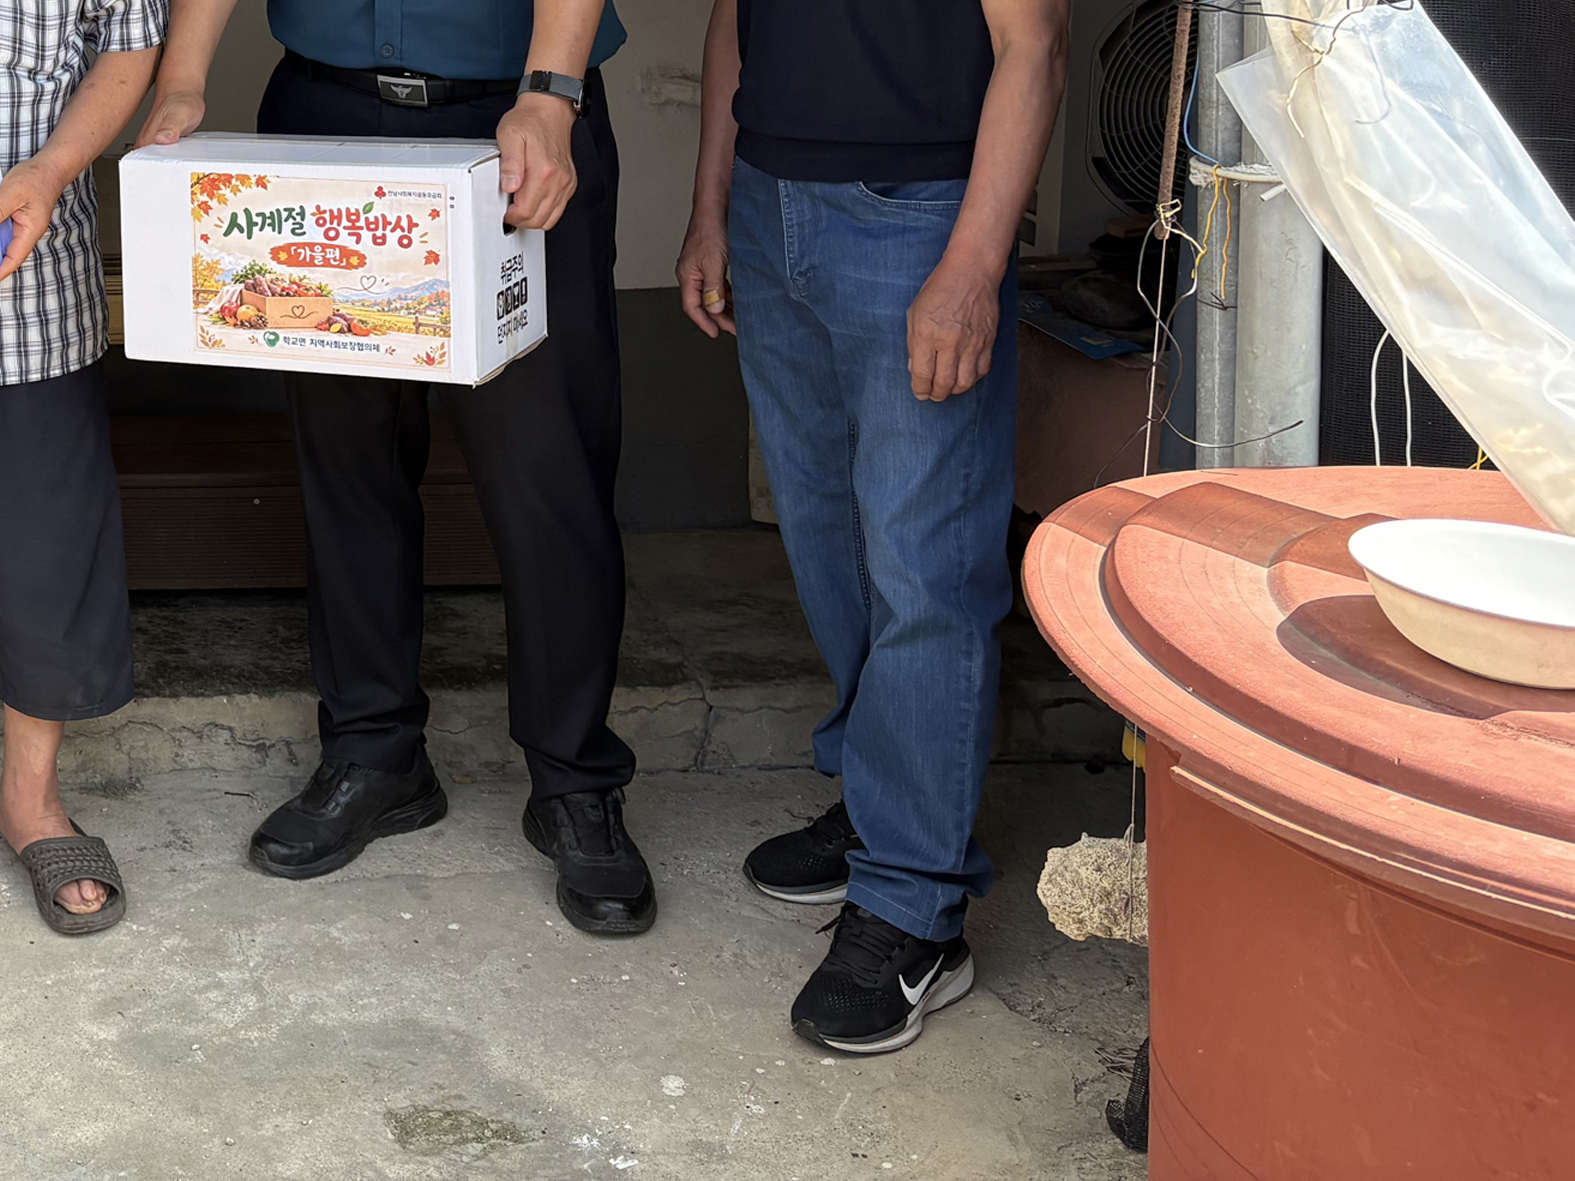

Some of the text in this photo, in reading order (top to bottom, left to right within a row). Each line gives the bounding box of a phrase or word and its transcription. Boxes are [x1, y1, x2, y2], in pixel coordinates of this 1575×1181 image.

[222, 205, 420, 249] 사계절 행복밥상
[500, 250, 524, 285] 취급주의
[309, 338, 381, 352] 지역사회보장협의체
